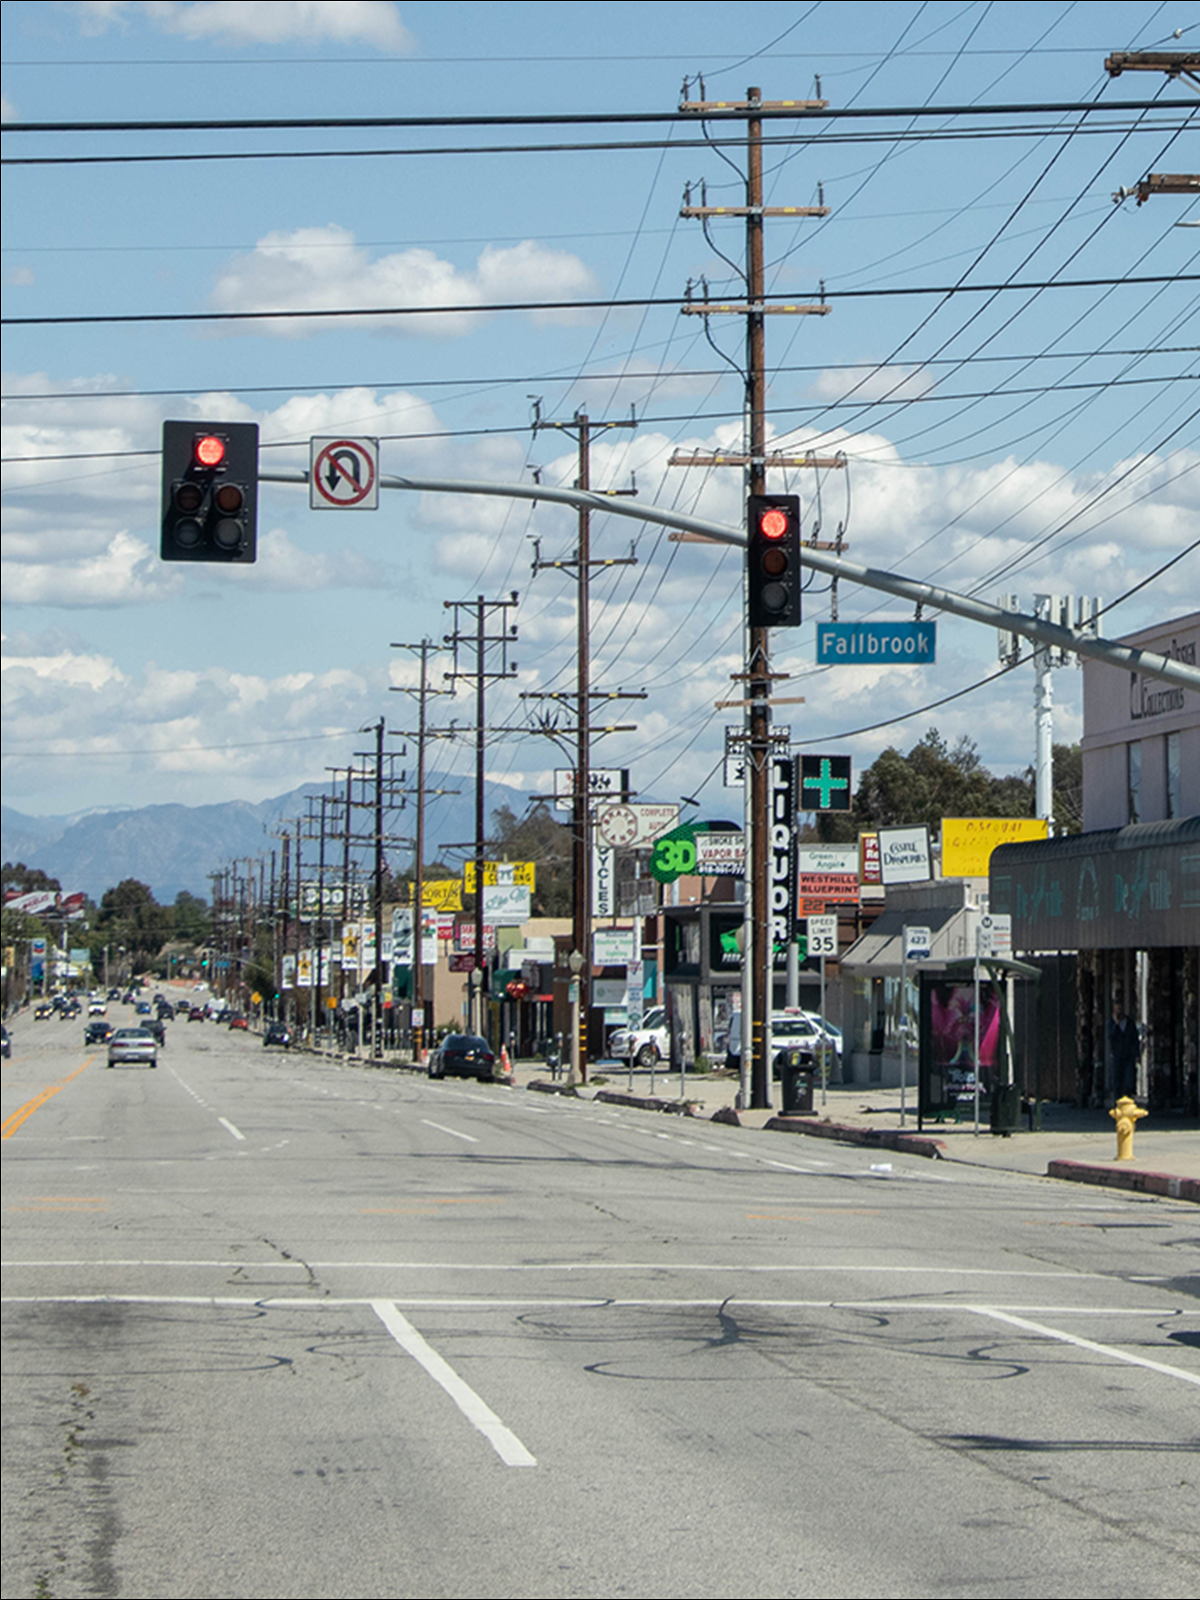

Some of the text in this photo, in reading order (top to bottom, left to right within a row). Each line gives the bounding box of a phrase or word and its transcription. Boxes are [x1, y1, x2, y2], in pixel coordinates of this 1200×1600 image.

[822, 632, 929, 655] Fallbrook
[640, 808, 676, 817] COMPLETE
[702, 848, 732, 858] VAPOR
[772, 765, 790, 940] LIQUOR
[801, 875, 858, 884] WESTHILLS
[801, 885, 859, 893] BLUEPRINT
[810, 918, 835, 926] SPEED
[811, 936, 835, 952] 35
[910, 936, 927, 945] 423
